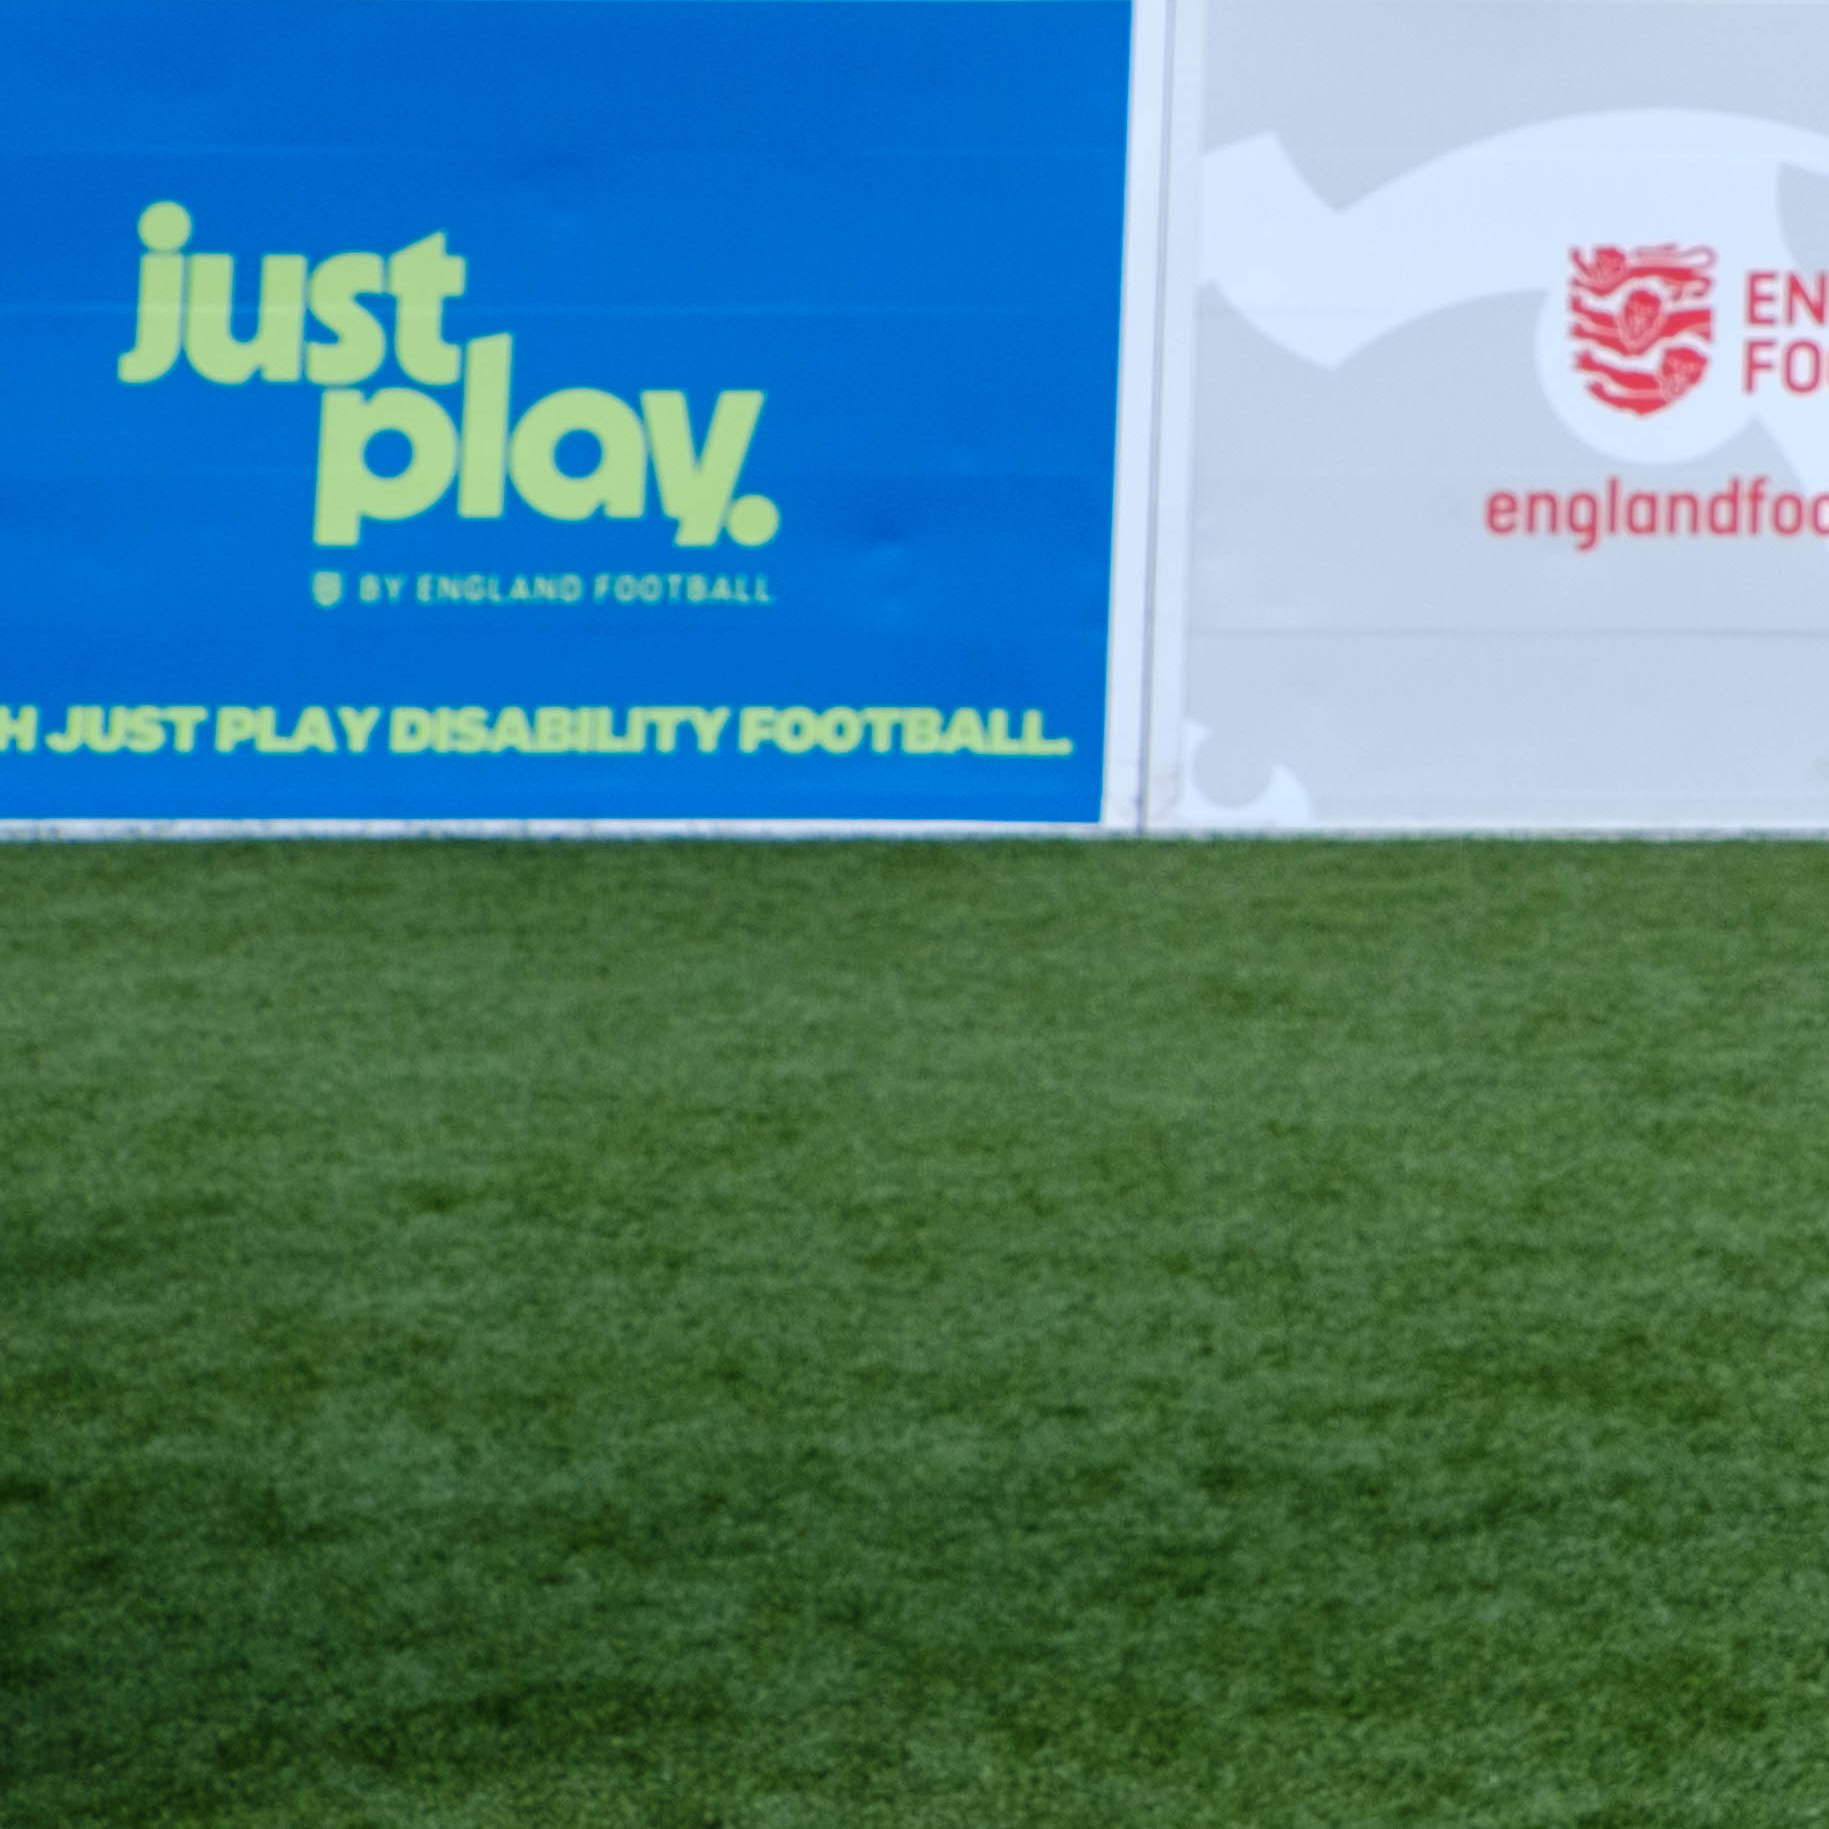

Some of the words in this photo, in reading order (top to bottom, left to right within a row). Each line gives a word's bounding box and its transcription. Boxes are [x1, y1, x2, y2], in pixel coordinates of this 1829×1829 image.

[119, 201, 465, 384] just
[313, 332, 780, 546] play.
[358, 574, 405, 602] BY
[417, 574, 583, 603] ENGLAND
[595, 574, 772, 603] FOOTBALL
[46, 705, 208, 753] JUST
[214, 705, 381, 753] PLAY
[389, 705, 728, 753] DISABILITY
[740, 706, 1072, 755] FOOTBALL.
